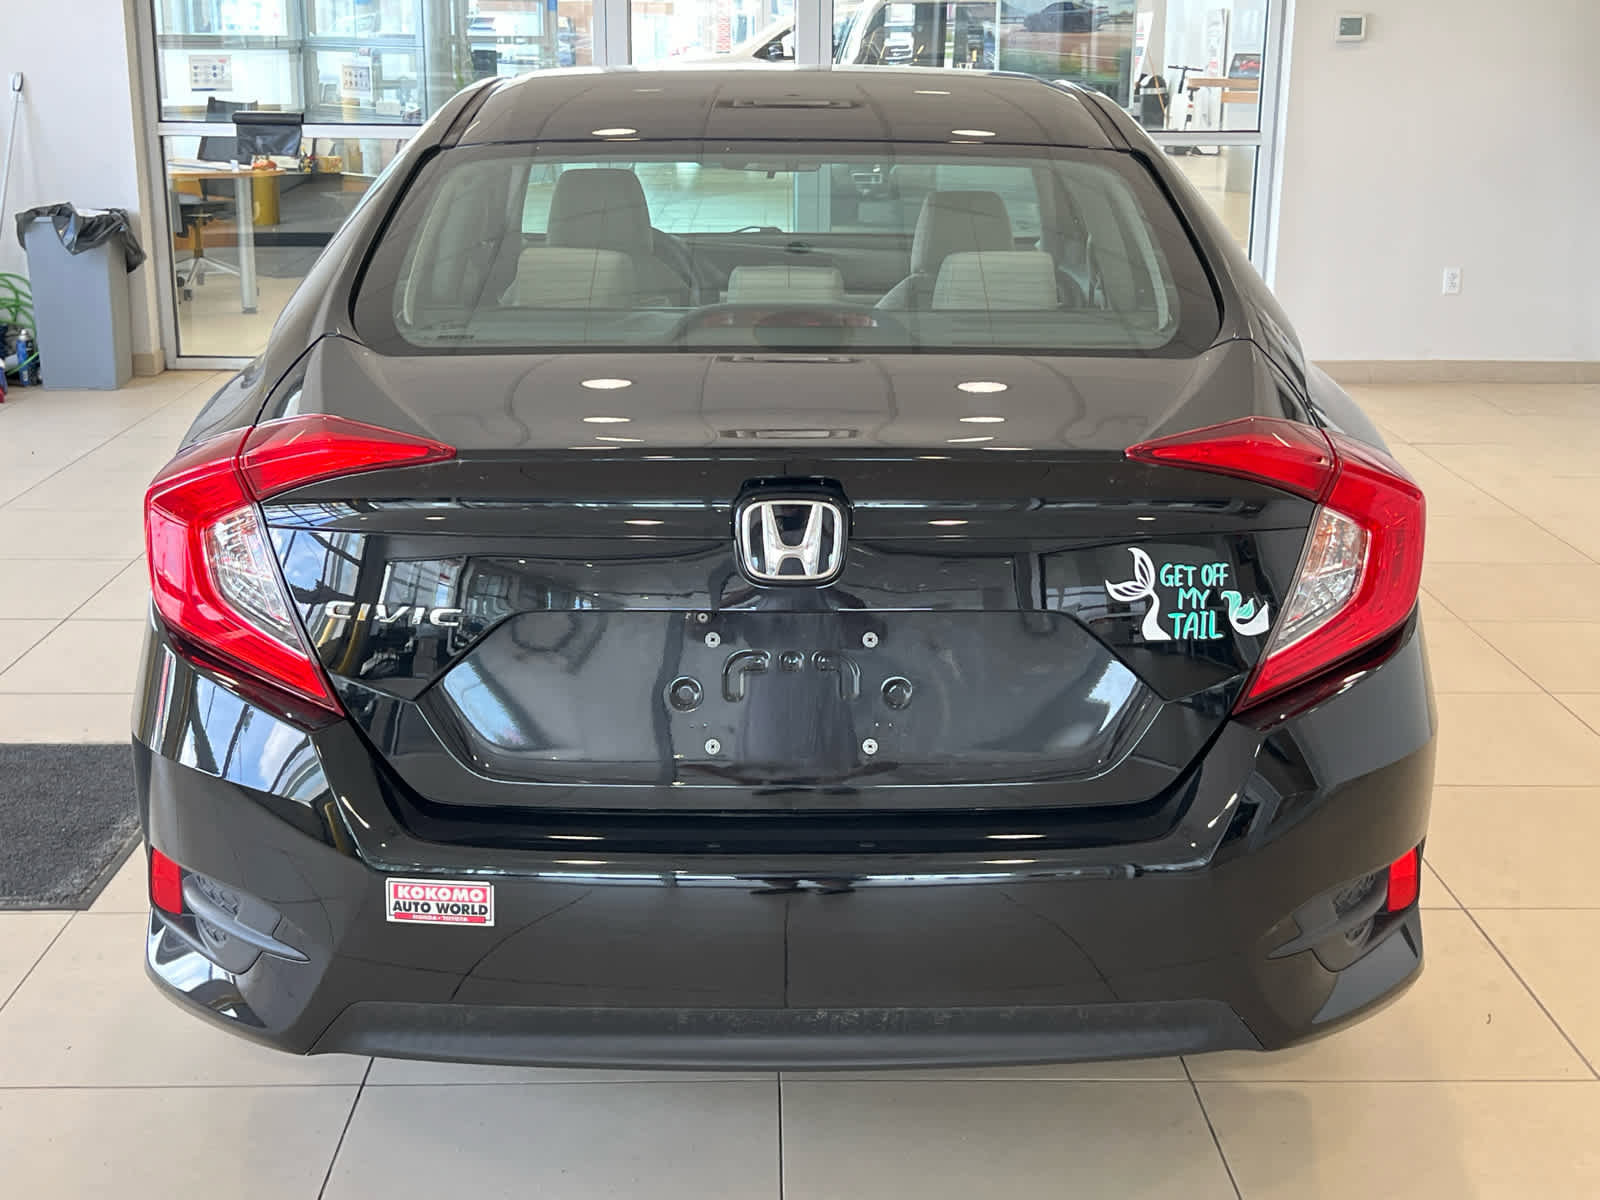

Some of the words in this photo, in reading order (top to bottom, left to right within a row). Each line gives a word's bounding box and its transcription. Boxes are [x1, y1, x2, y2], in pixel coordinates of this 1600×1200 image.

[1159, 563, 1198, 587] GET
[1200, 562, 1230, 587] OFF
[1177, 587, 1211, 610] MY
[324, 600, 463, 627] CIVIC
[1167, 610, 1224, 640] TAIL
[397, 885, 484, 902] KOKOMO
[393, 900, 431, 913] AUTO
[436, 902, 489, 916] WORLD
